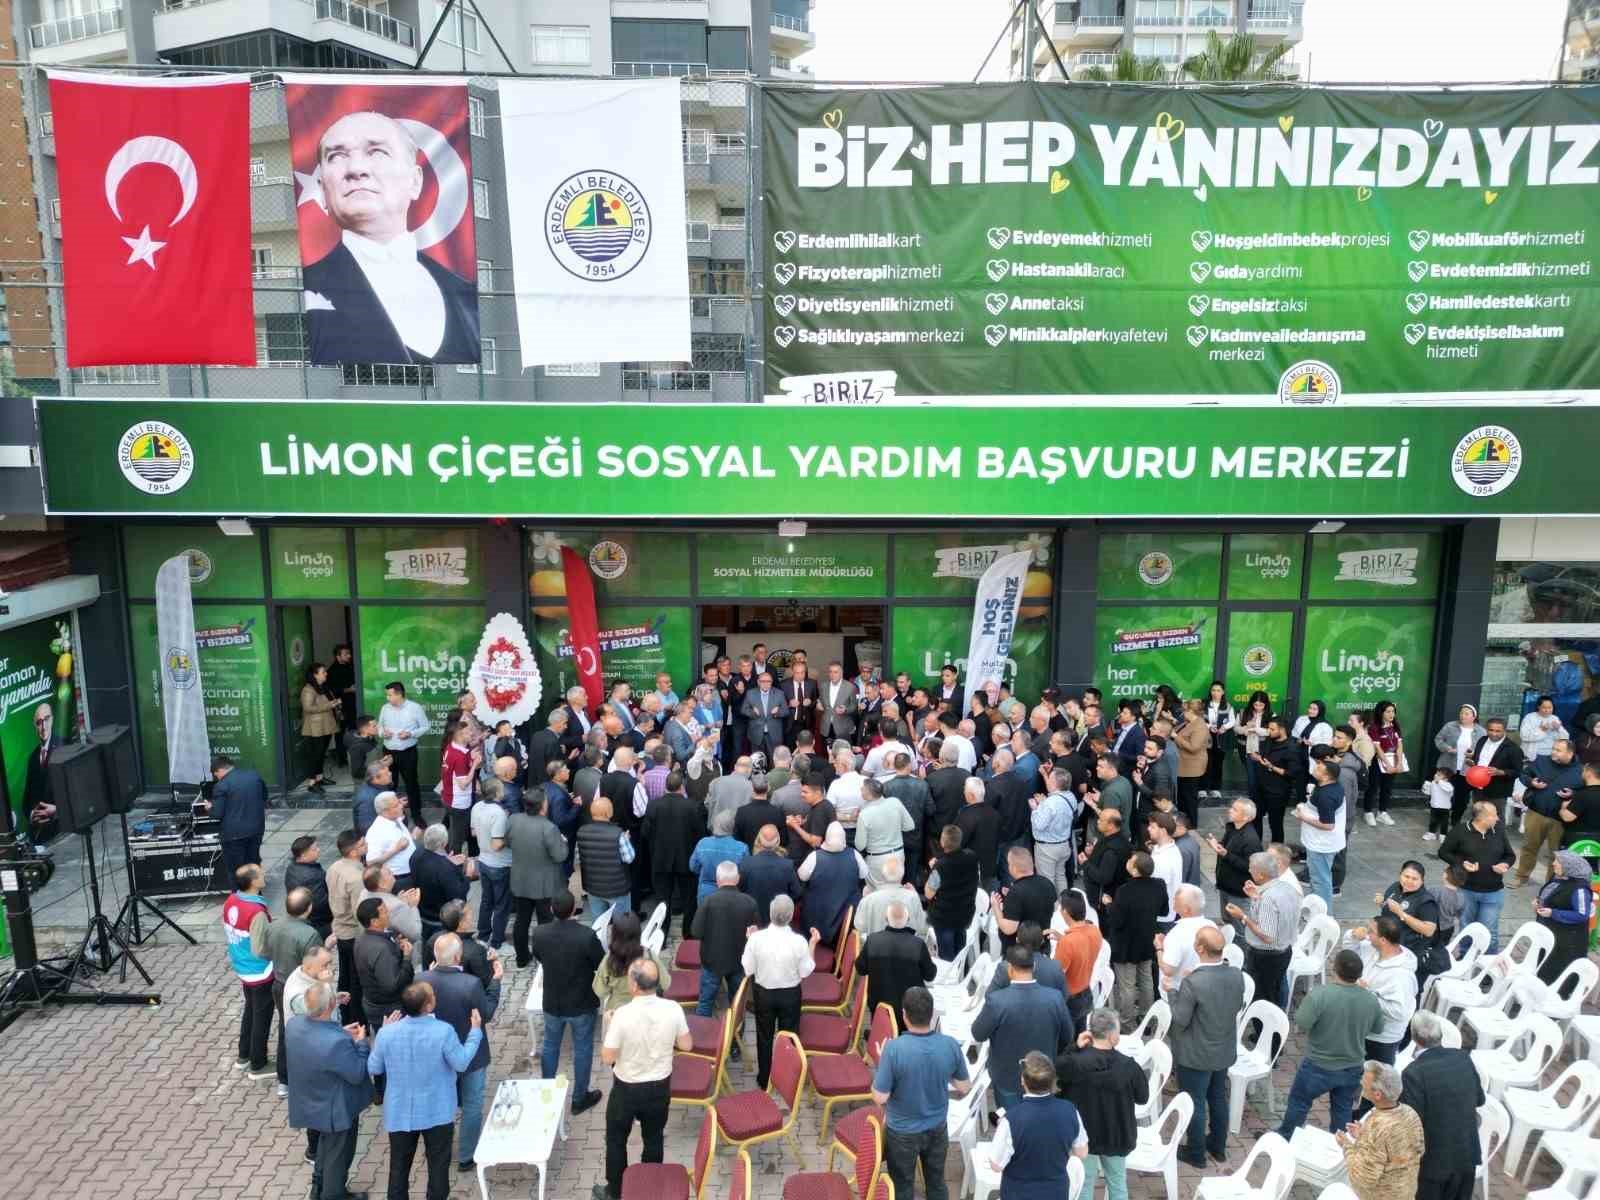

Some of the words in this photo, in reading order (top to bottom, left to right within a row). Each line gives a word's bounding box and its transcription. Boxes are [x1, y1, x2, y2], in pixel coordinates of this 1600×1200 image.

[930, 121, 1077, 186] HEP
[1089, 122, 1600, 188] YANINIZDAYIZ
[585, 263, 616, 276] 1954
[1209, 347, 1265, 361] merkezi
[1426, 343, 1479, 360] hizmeti
[259, 434, 414, 478] LİMON
[428, 435, 583, 484] ÇİÇEĞİ
[597, 444, 776, 480] SOSYAL
[788, 445, 962, 479] YARDIM
[977, 445, 1197, 485] BAŞVURU
[1210, 437, 1410, 478] MERKEZİ
[713, 568, 752, 577] SOSYAL
[754, 567, 807, 577] HİZMETLER
[809, 566, 874, 577] MÜDÜRLÜĞÜ
[982, 598, 1000, 636] HOŞ
[997, 576, 1019, 657] GELDİNİZ
[381, 650, 466, 673] Limon
[1107, 664, 1137, 680] her
[1321, 649, 1404, 673] Limon
[0, 665, 37, 689] aman
